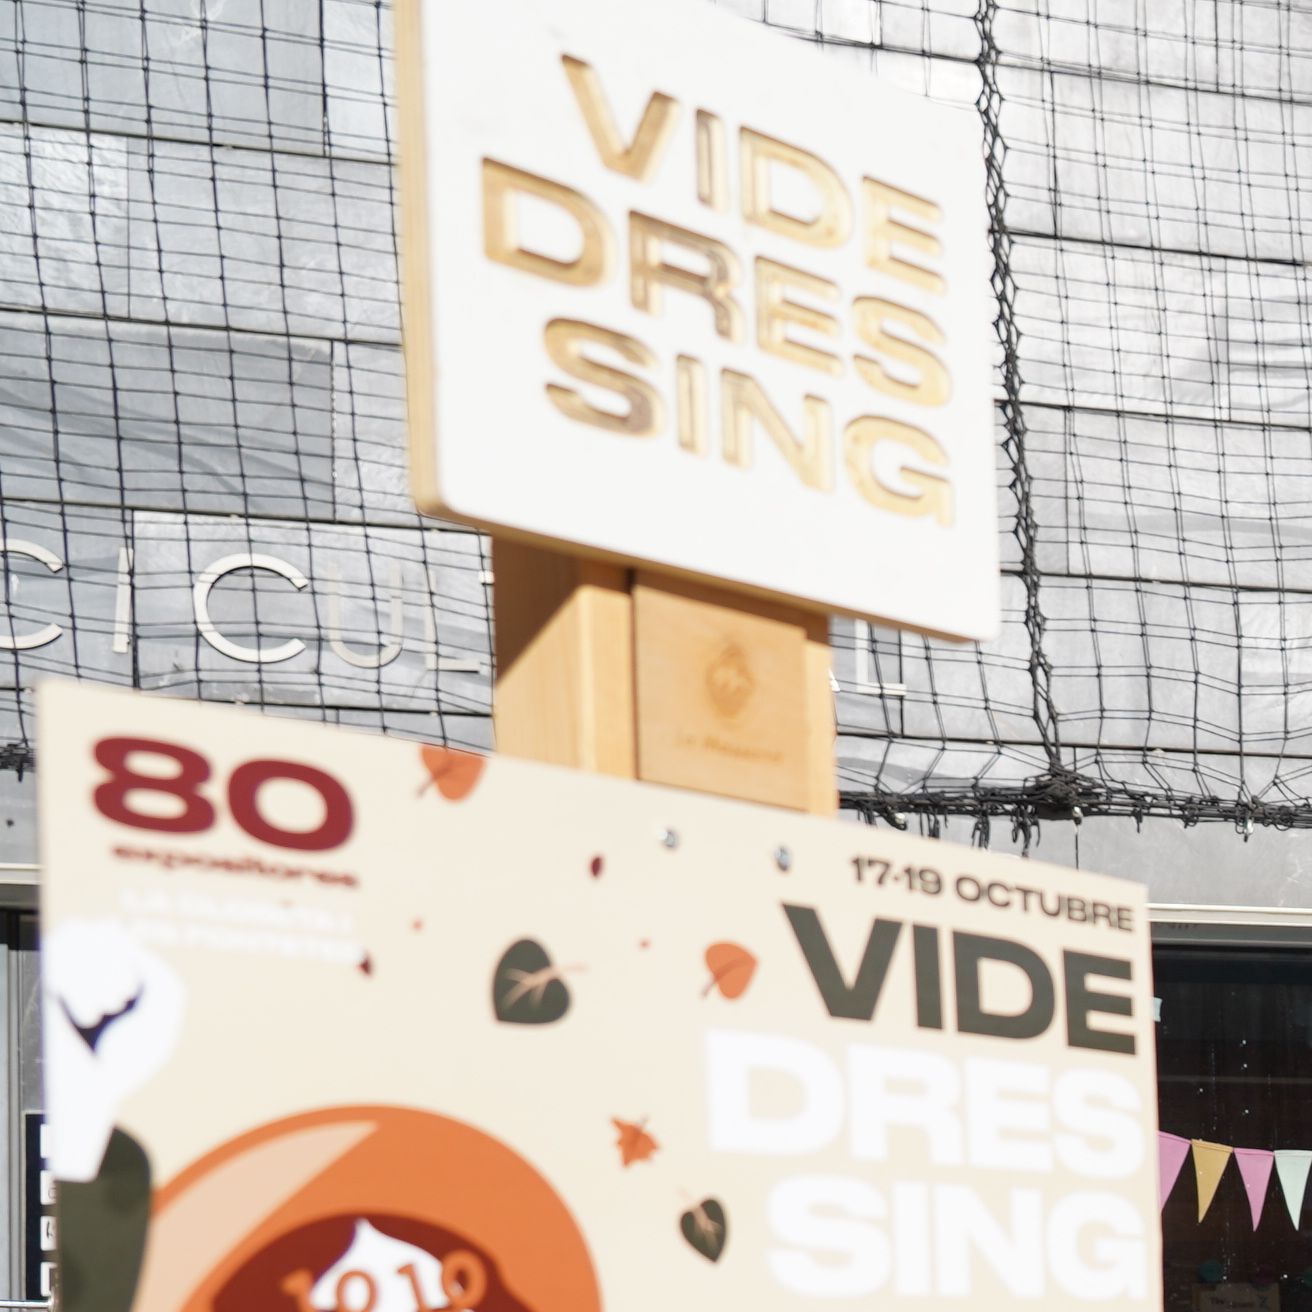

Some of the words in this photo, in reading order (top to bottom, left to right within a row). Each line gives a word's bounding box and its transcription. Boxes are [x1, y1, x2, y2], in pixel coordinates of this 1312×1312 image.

[560, 53, 948, 297] VIDE
[481, 155, 954, 408] DRES
[544, 315, 957, 530] SING
[93, 737, 357, 851] 80
[782, 902, 1137, 1055] VIDE
[955, 875, 1136, 933] OCTUBRE
[706, 1029, 1146, 1180] DRES
[766, 1174, 1148, 1300] SING
